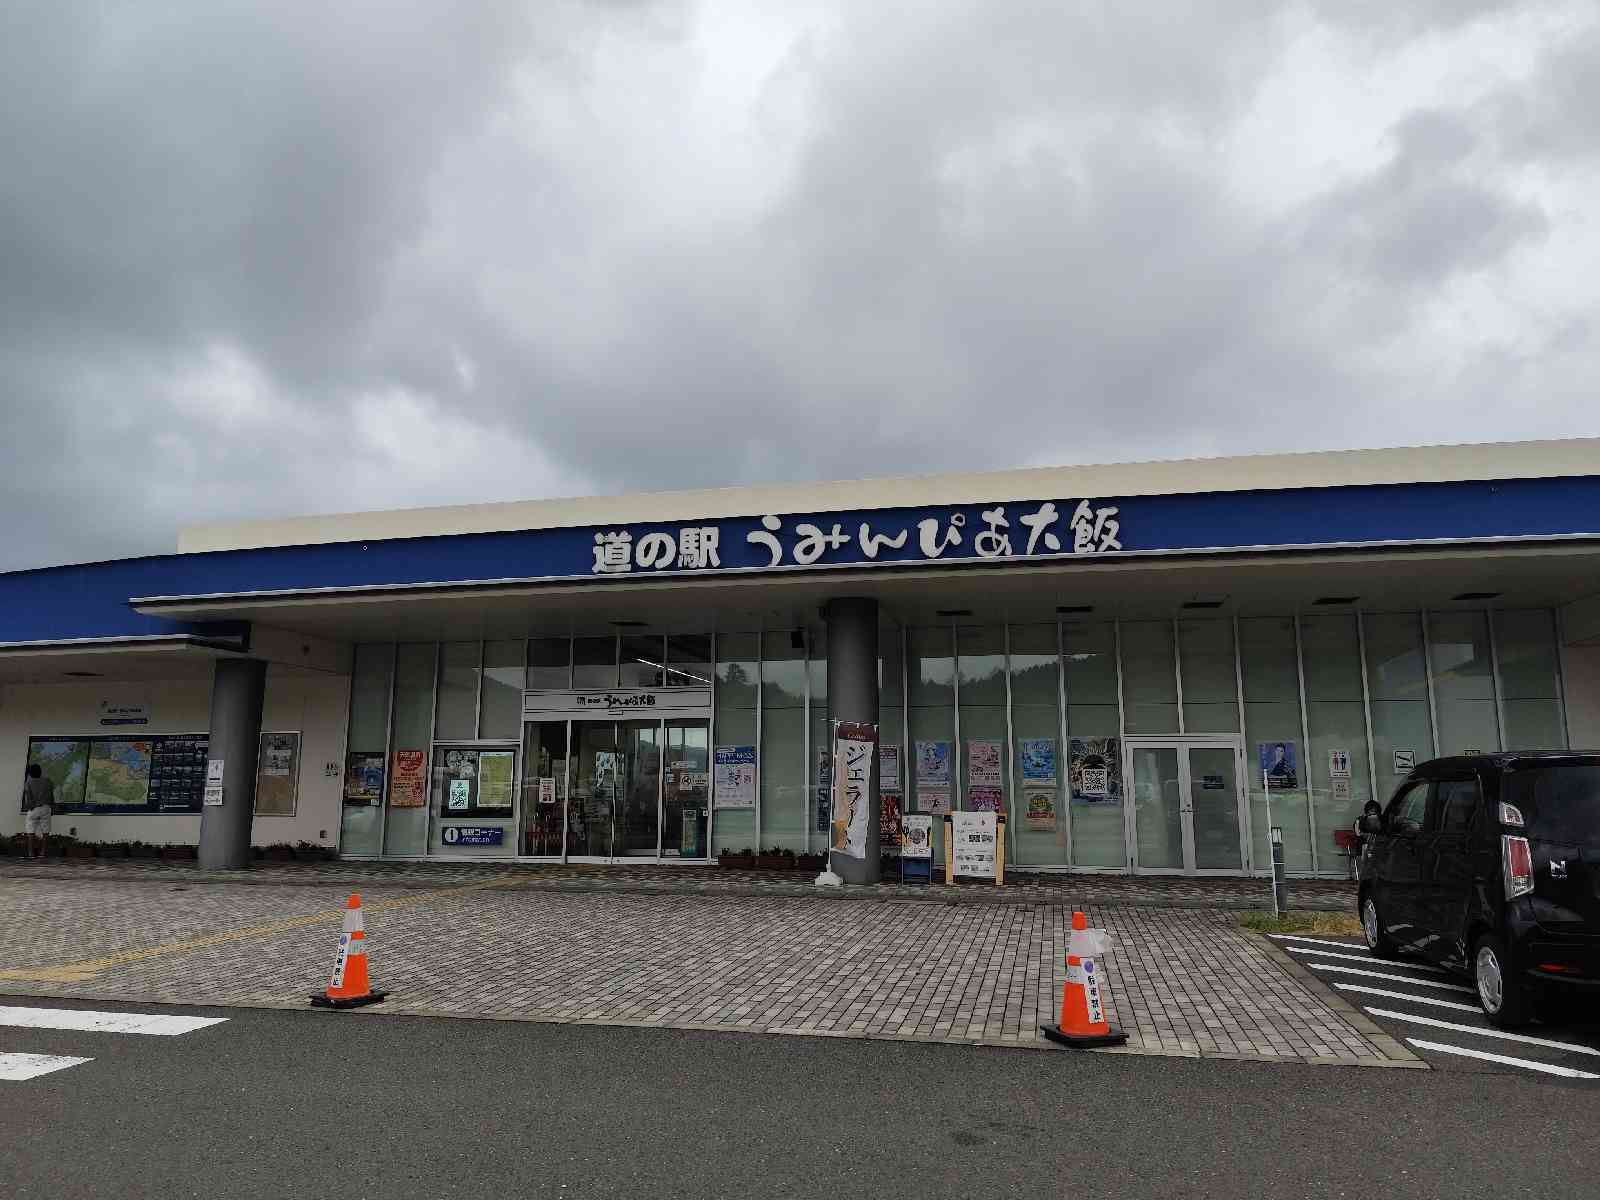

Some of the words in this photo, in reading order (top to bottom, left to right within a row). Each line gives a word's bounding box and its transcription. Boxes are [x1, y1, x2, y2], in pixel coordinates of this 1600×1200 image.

[591, 525, 721, 575] 道の駅
[746, 499, 1123, 568] うみんぴあ大飯
[844, 744, 867, 850] ジェラート
[1087, 974, 1102, 1021] 駐車禁止
